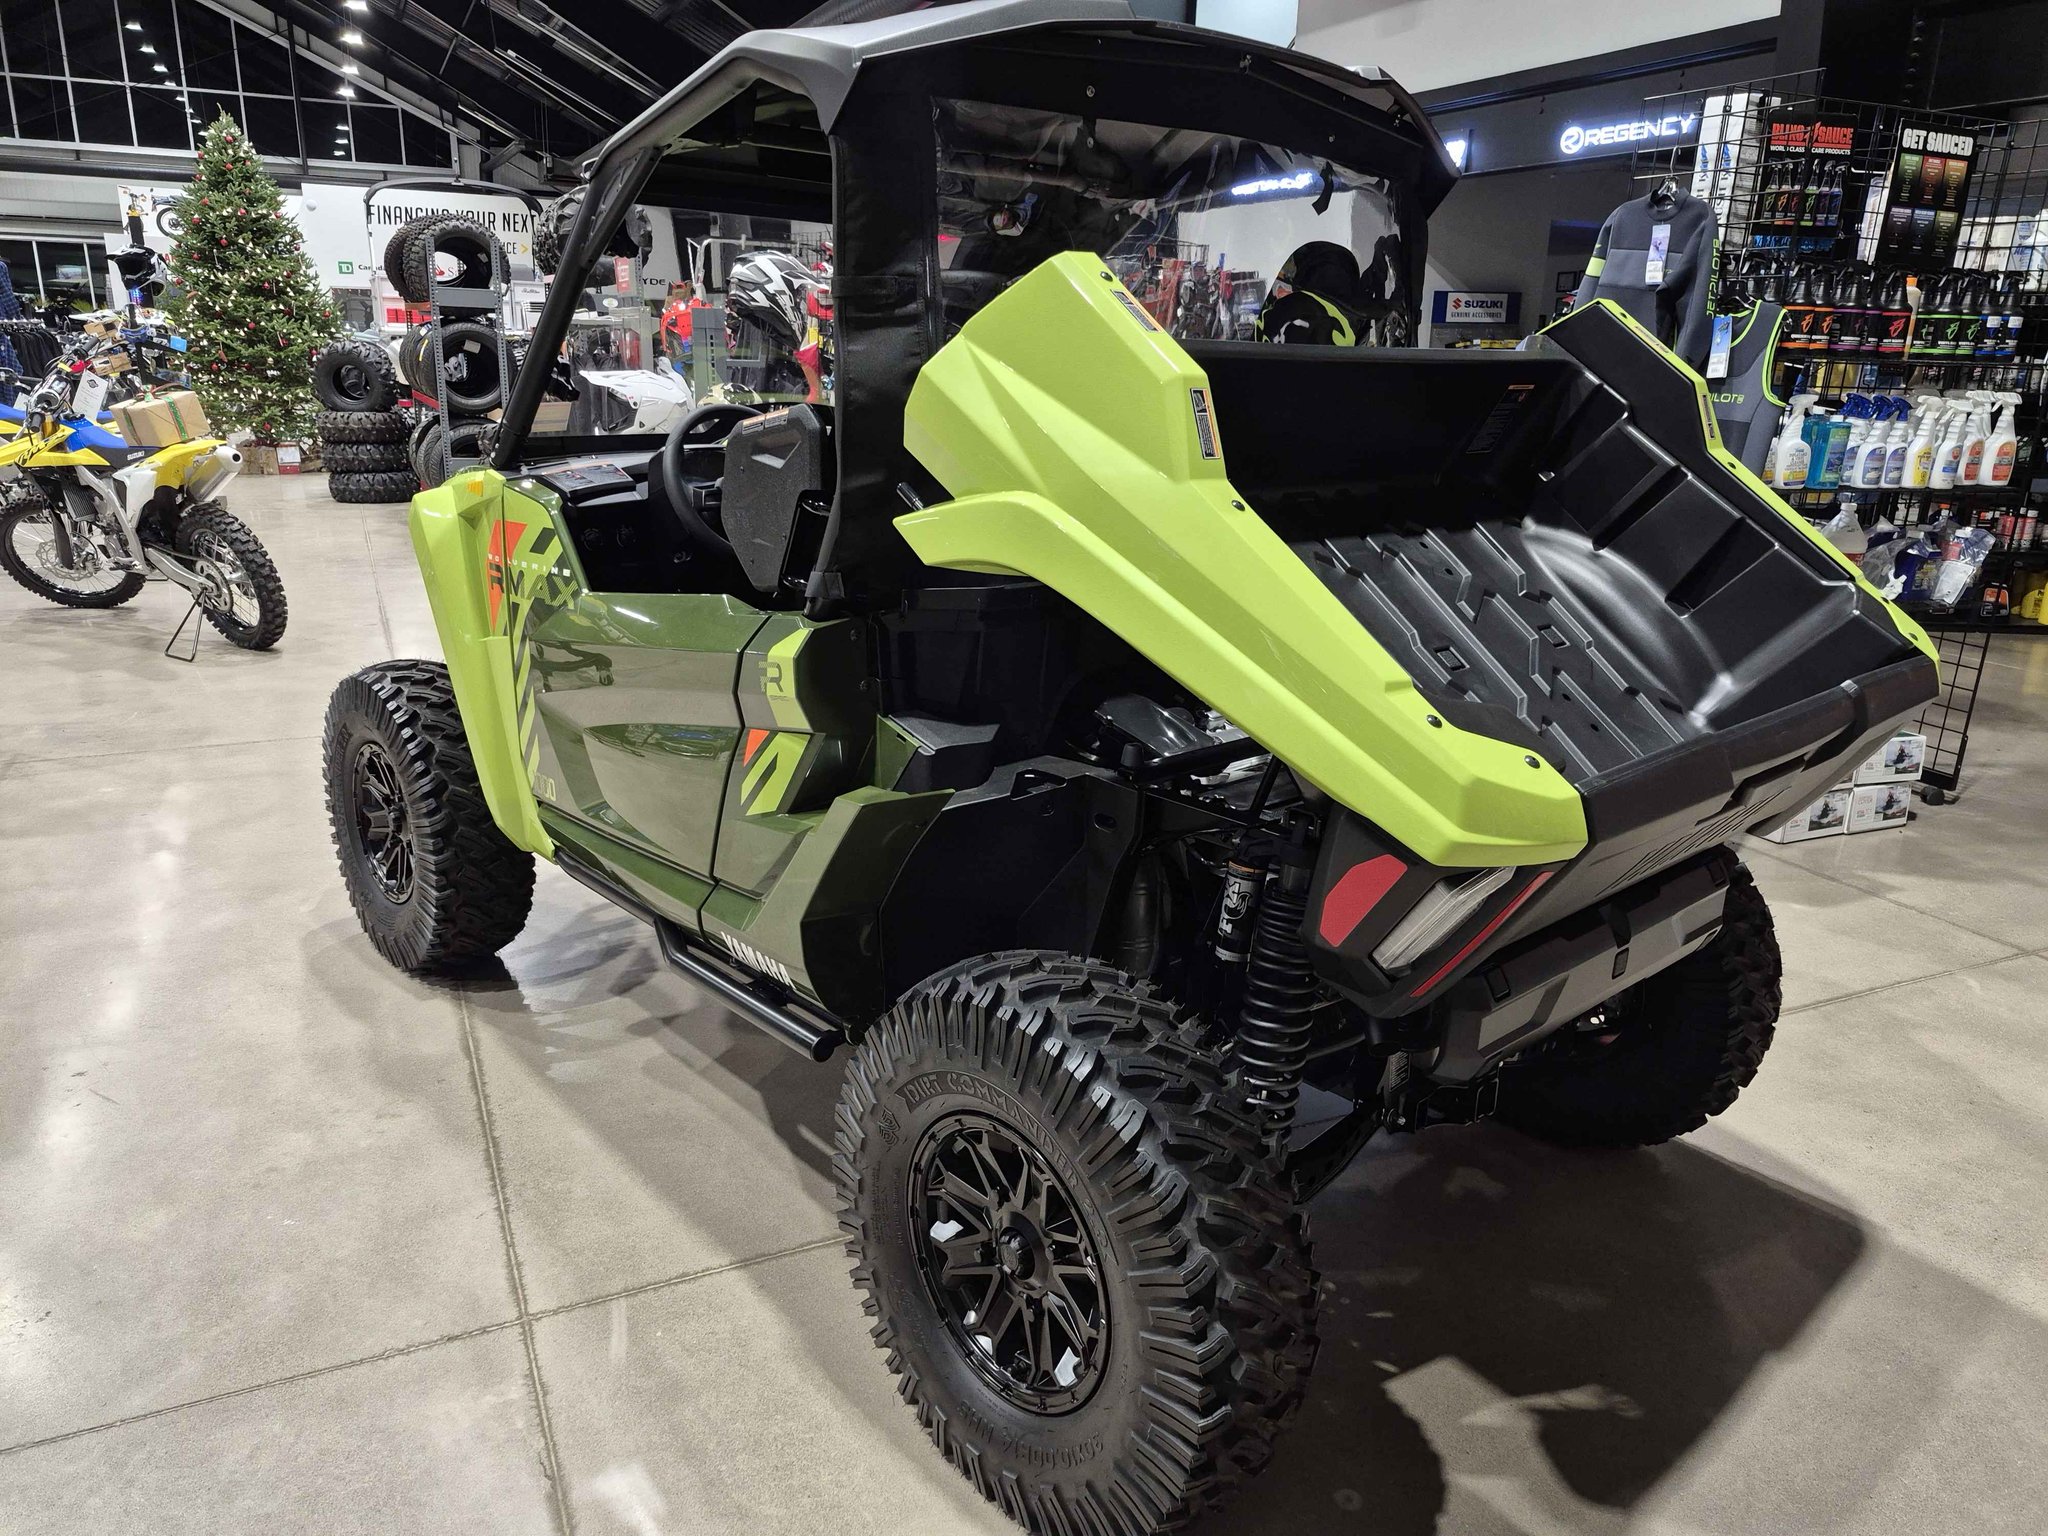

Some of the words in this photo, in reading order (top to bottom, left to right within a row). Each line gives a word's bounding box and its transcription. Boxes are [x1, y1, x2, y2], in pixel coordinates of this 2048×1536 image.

[1584, 112, 1696, 147] REGENCY
[1771, 123, 1805, 141] BLING
[1818, 126, 1854, 144] SAUCE
[1902, 128, 1928, 150] GET
[1926, 131, 1974, 156] SAUCED
[367, 204, 449, 225] FINANC
[502, 212, 536, 235] NEXT
[1706, 247, 1721, 318] JETPILOT
[1464, 300, 1503, 309] SUZUKI
[488, 553, 571, 577] WOLVERINE
[720, 931, 797, 990] YAMAHA
[903, 1075, 942, 1103] DIRT
[948, 1073, 1080, 1190] COMMANDER
